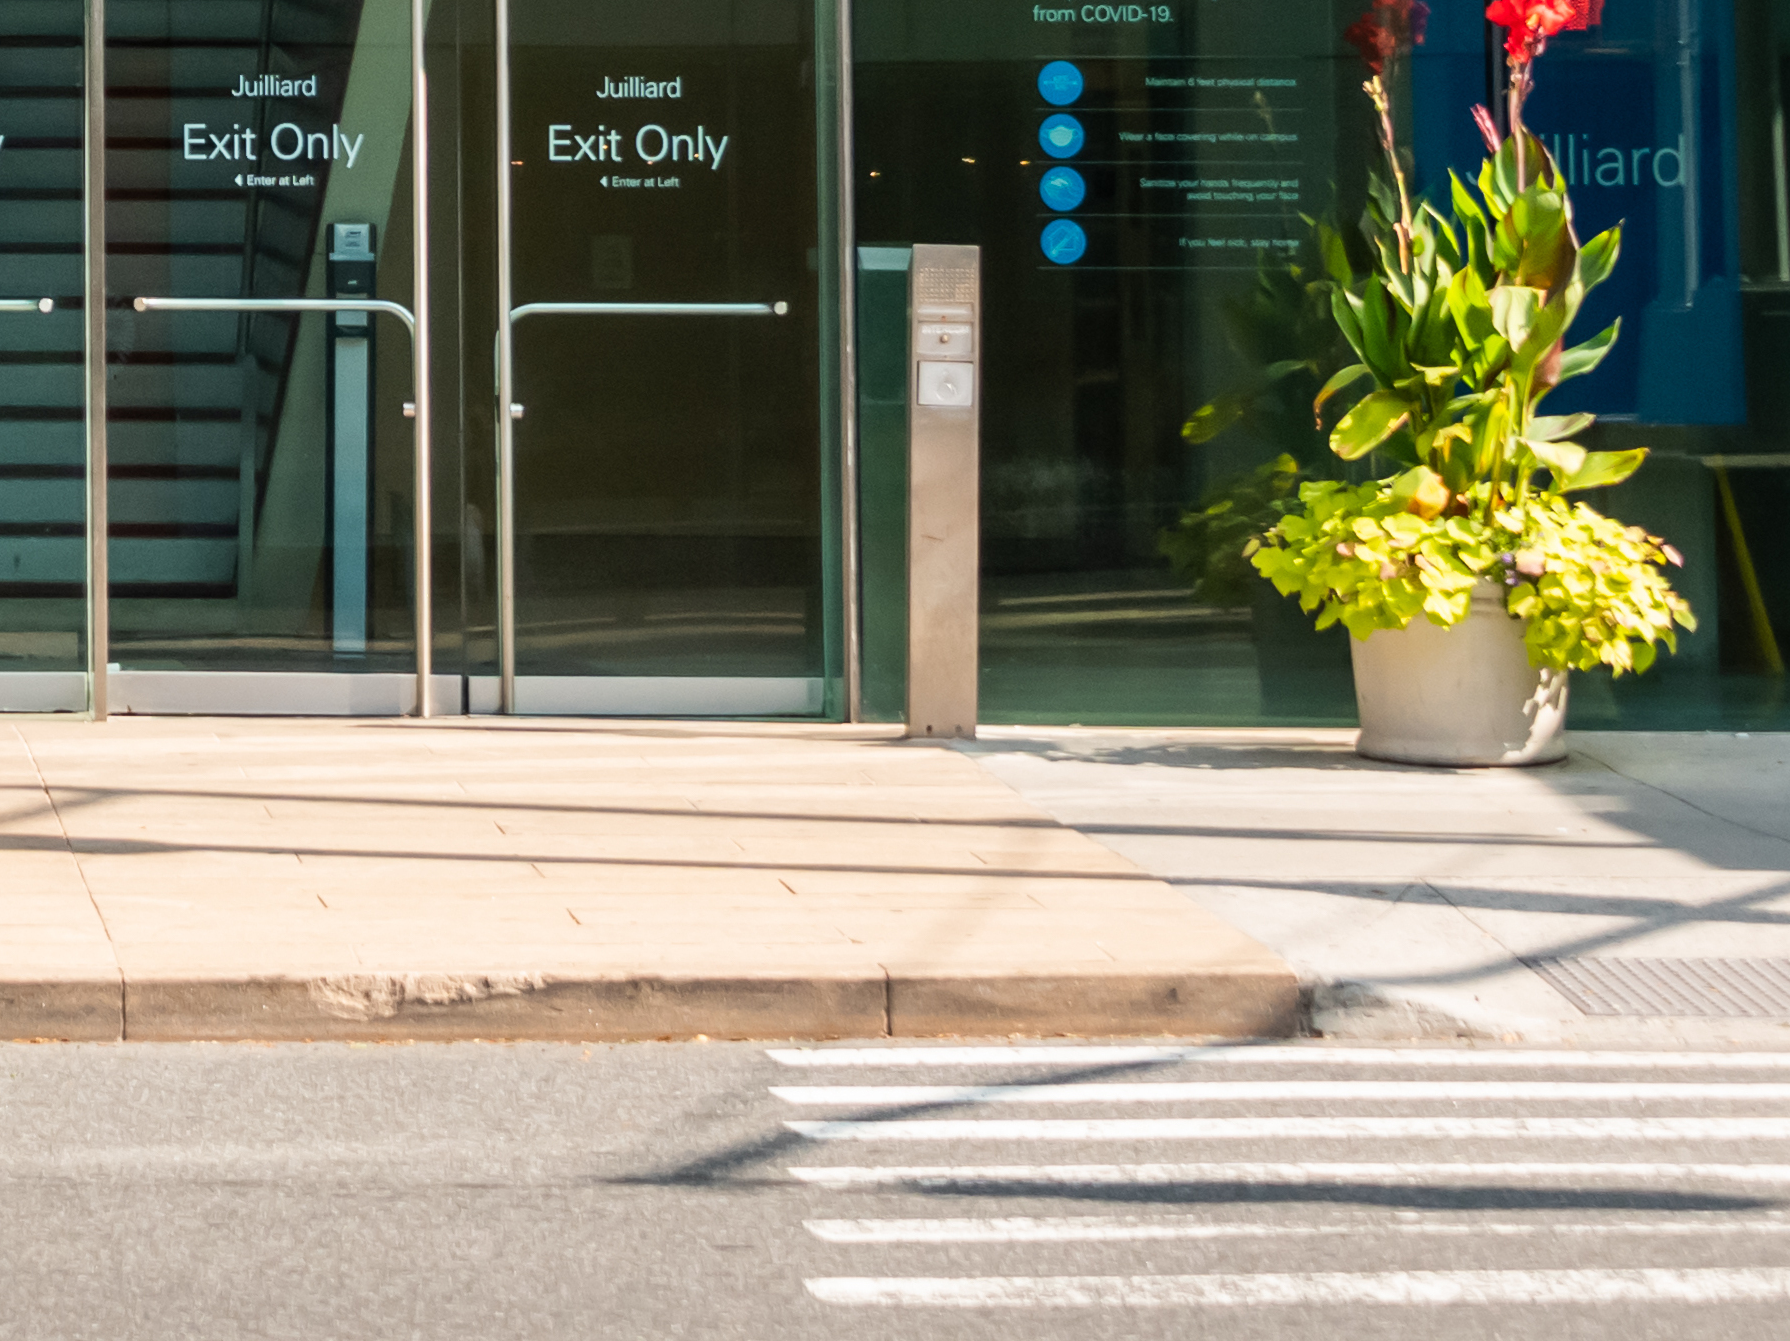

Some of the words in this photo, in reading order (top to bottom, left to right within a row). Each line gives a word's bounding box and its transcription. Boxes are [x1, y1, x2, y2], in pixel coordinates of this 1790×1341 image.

[1032, 4, 1076, 22] from
[1080, 4, 1175, 23] COVID-19.
[231, 74, 317, 97] Juilliard
[596, 75, 682, 98] Juilliard
[183, 123, 257, 160] Exit
[270, 122, 364, 169] Only
[548, 124, 622, 162] Exit
[635, 124, 729, 170] Only
[1465, 133, 1687, 187] lliard
[246, 174, 276, 186] Enter
[278, 174, 290, 186] at
[292, 174, 315, 186] Left
[611, 176, 642, 187] Enter
[644, 176, 655, 187] at
[657, 176, 680, 187] Left
